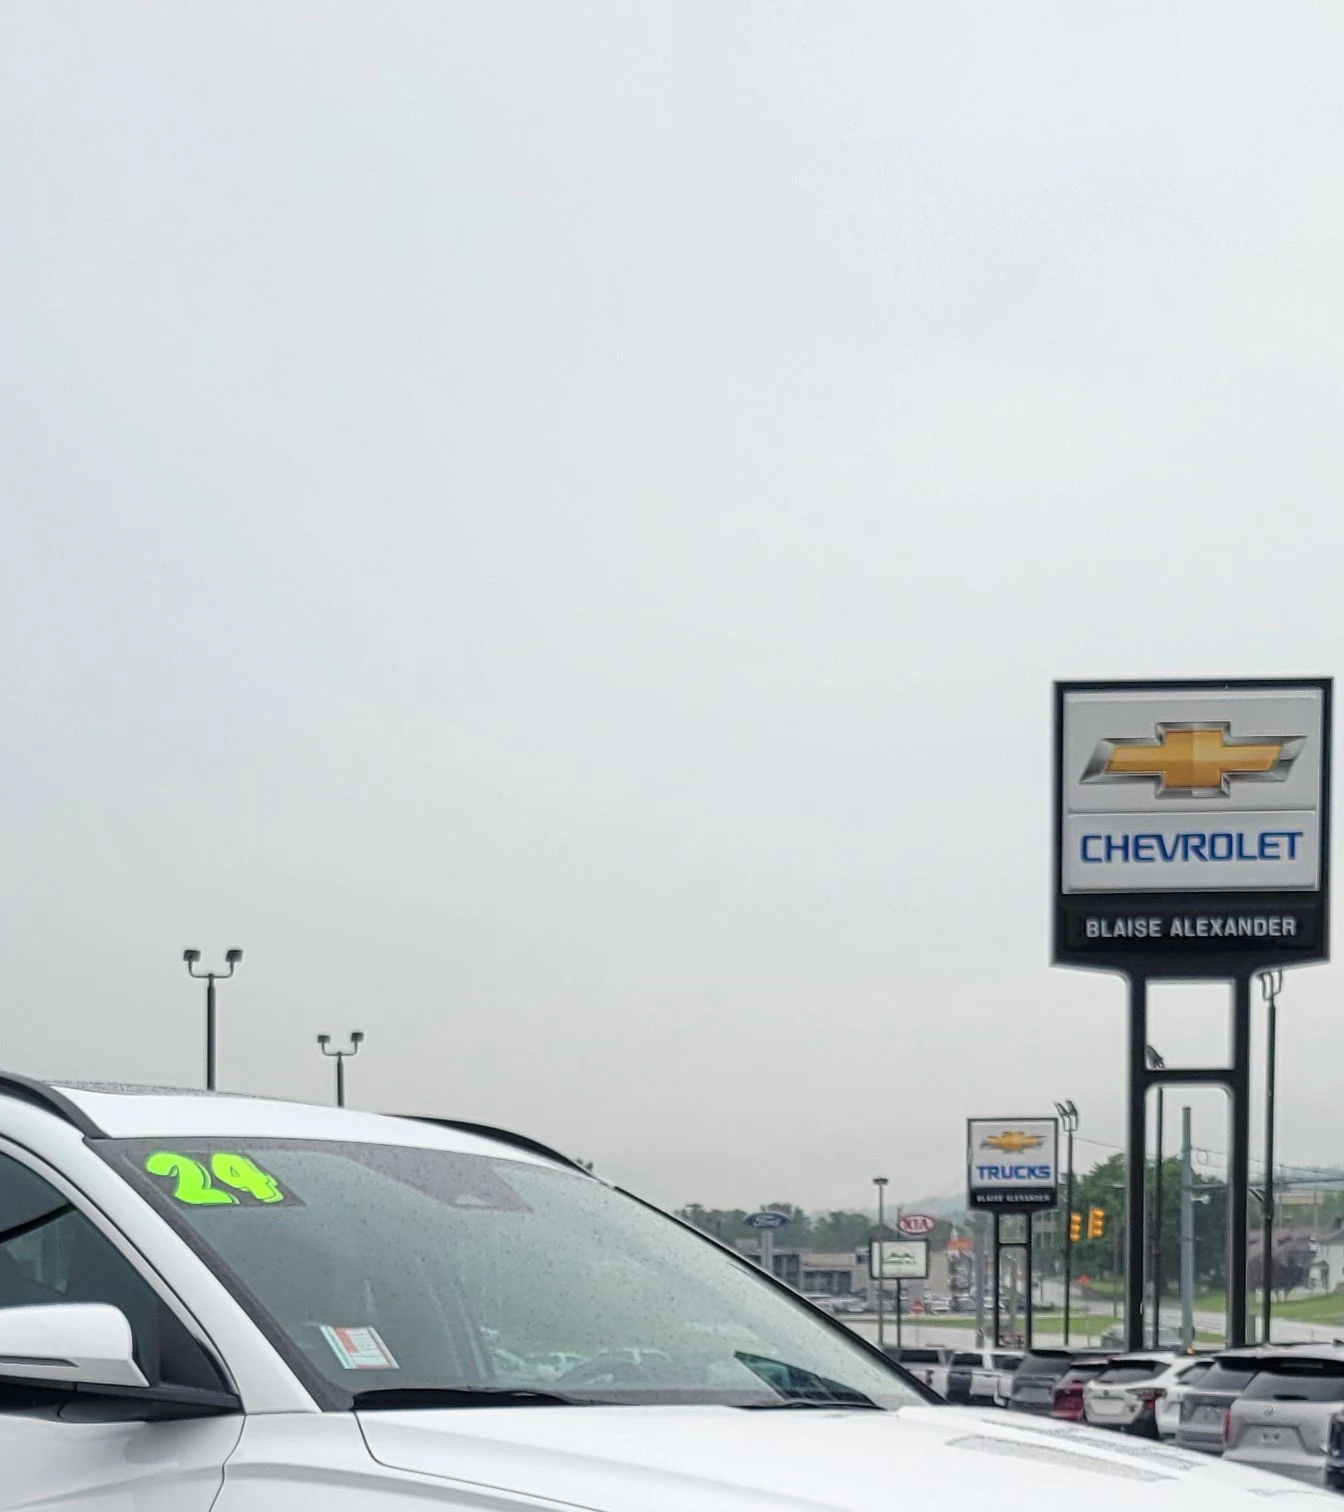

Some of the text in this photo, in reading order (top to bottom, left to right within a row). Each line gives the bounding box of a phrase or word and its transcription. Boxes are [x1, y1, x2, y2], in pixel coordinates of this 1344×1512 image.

[1079, 831, 1304, 864] CHEVROLET
[1085, 915, 1298, 939] BLAISE ALEXANDER
[145, 1151, 285, 1206] 24
[976, 1164, 1051, 1180] TRUCKS
[902, 1217, 931, 1231] KIA
